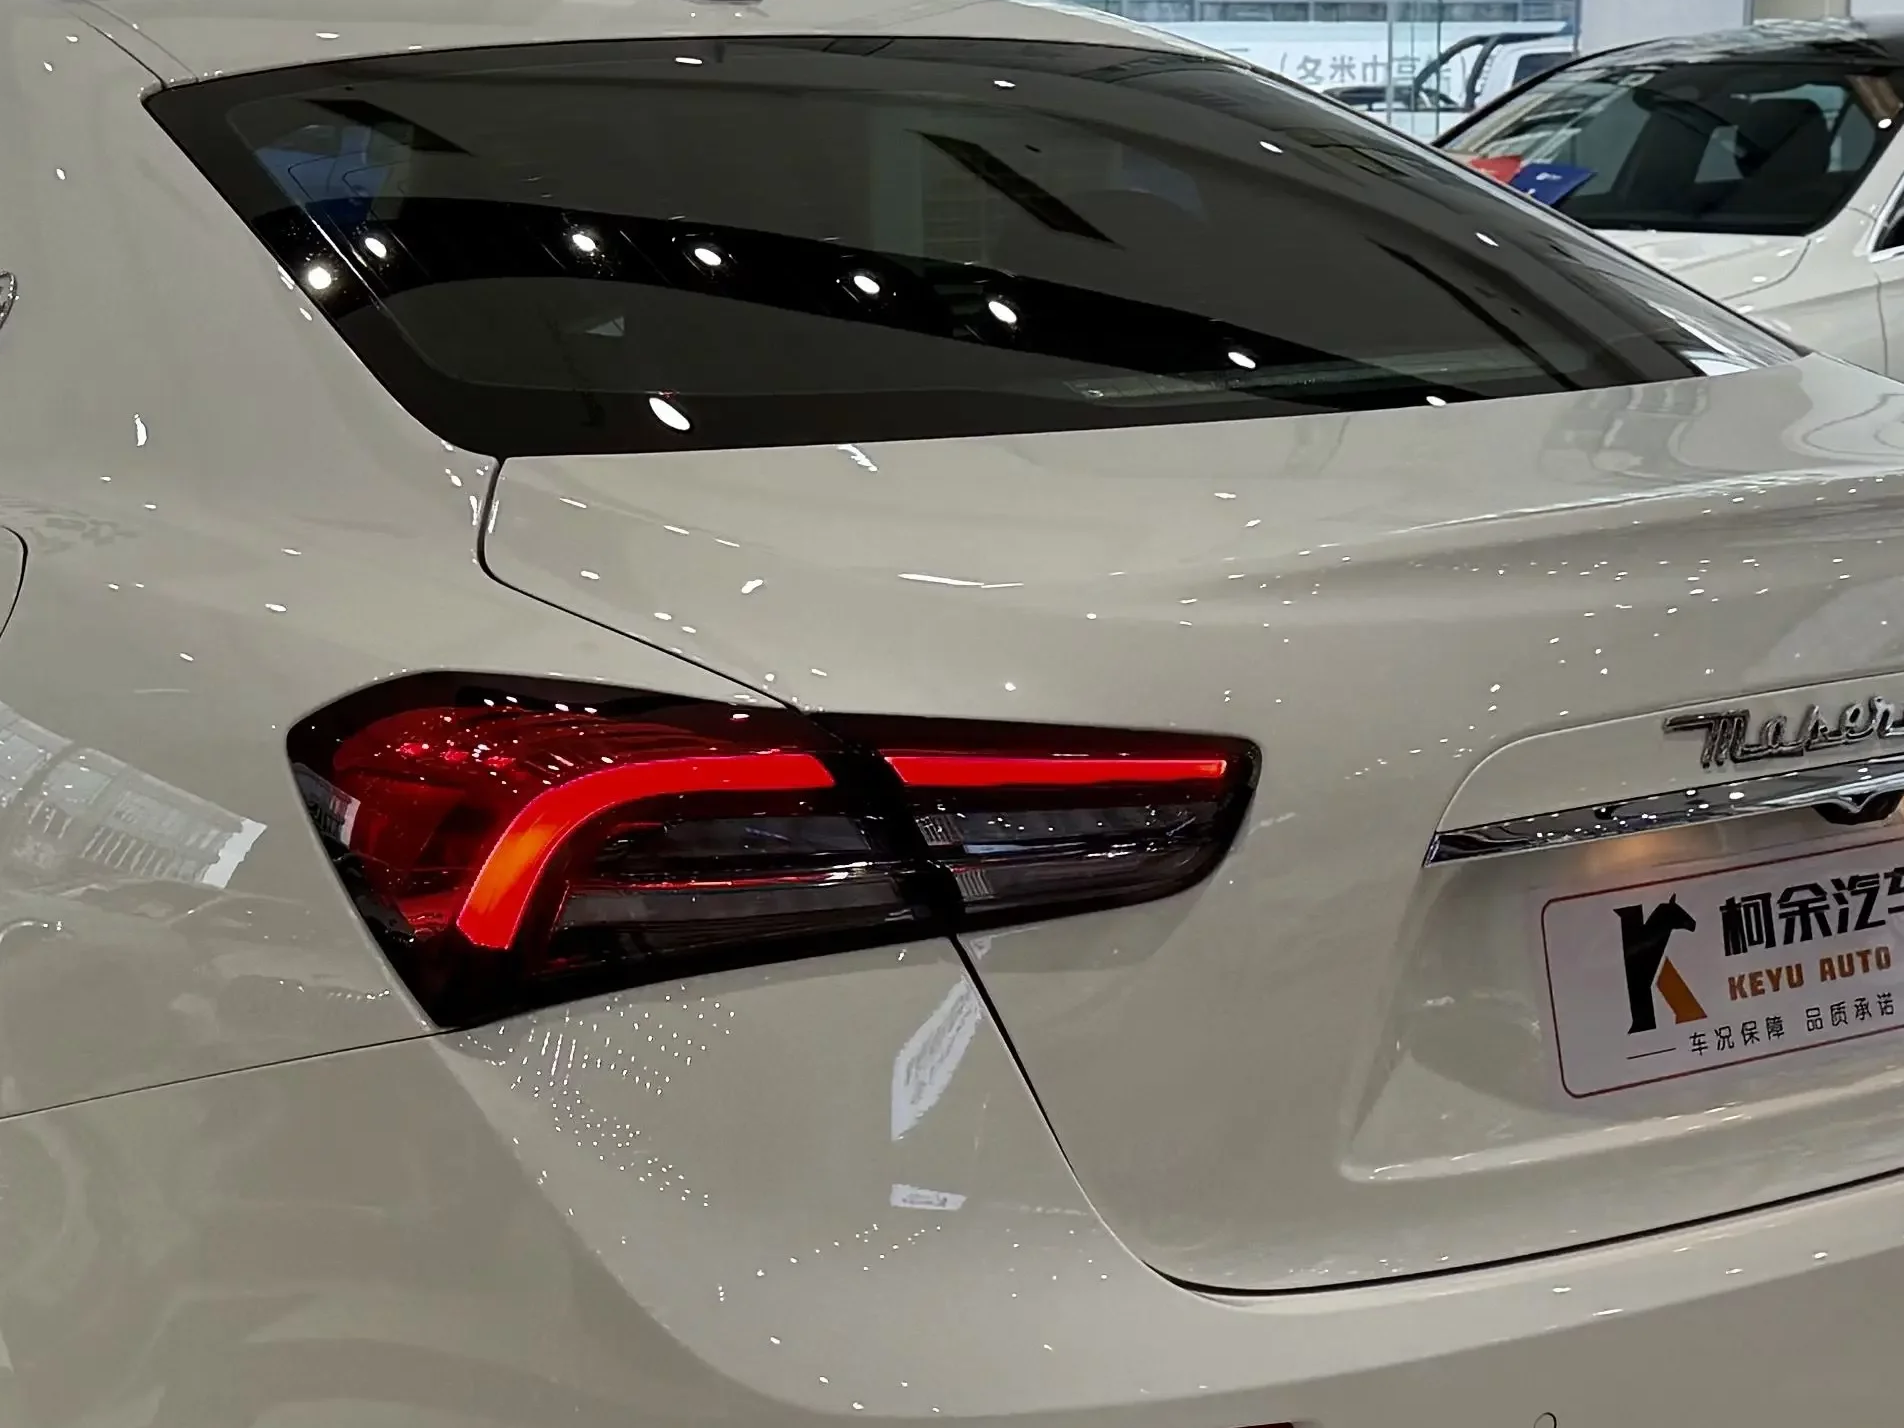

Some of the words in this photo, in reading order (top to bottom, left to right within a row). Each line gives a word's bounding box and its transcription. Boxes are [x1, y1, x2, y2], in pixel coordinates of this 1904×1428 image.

[1727, 965, 1805, 1002] KEYU
[1820, 945, 1893, 983] AUTO
[1688, 1015, 1786, 1056] 车况保障
[1804, 991, 1895, 1032] 品质承诺
